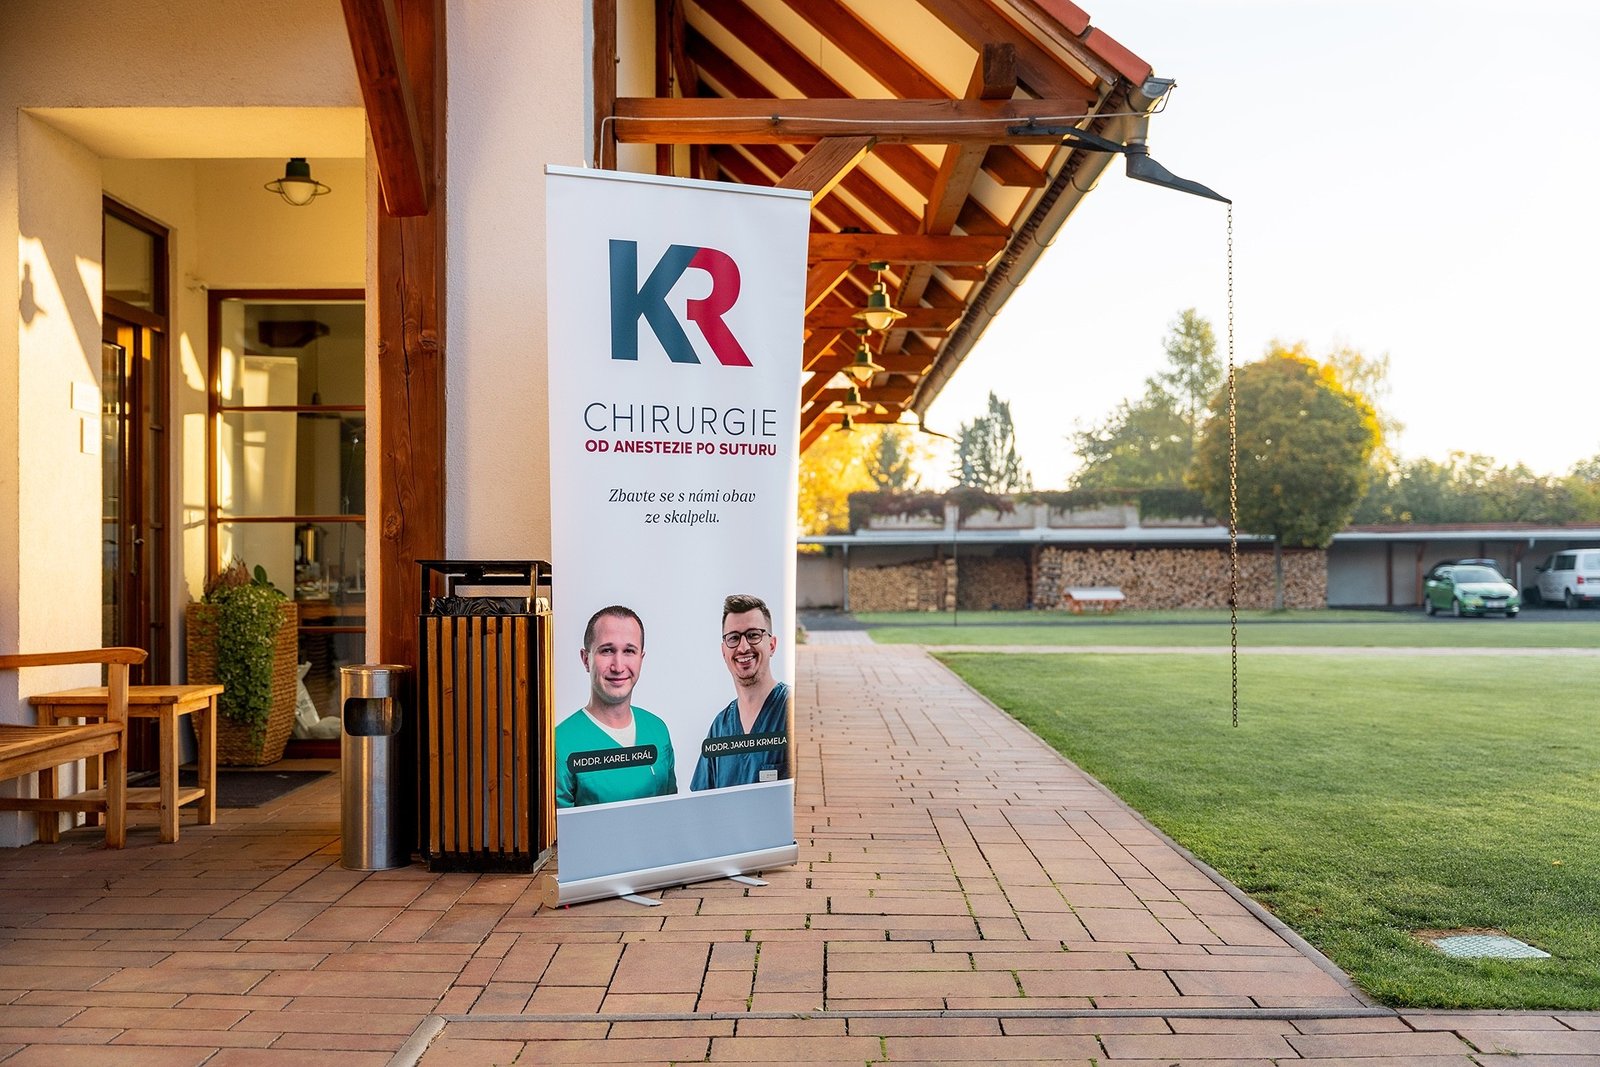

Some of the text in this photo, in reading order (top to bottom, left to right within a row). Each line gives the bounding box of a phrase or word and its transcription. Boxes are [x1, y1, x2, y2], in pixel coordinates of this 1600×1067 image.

[609, 239, 753, 367] KR
[584, 402, 777, 436] CHIRURGIE
[585, 439, 777, 456] OD ANESTEZIE PO SUTURU
[609, 488, 756, 503] Zbavte se s námi obav
[644, 510, 720, 526] ze skalpelu.
[705, 736, 787, 753] MDDR. JAKUB KRMELA
[573, 750, 653, 768] MDDR. KAREL KRÁL
